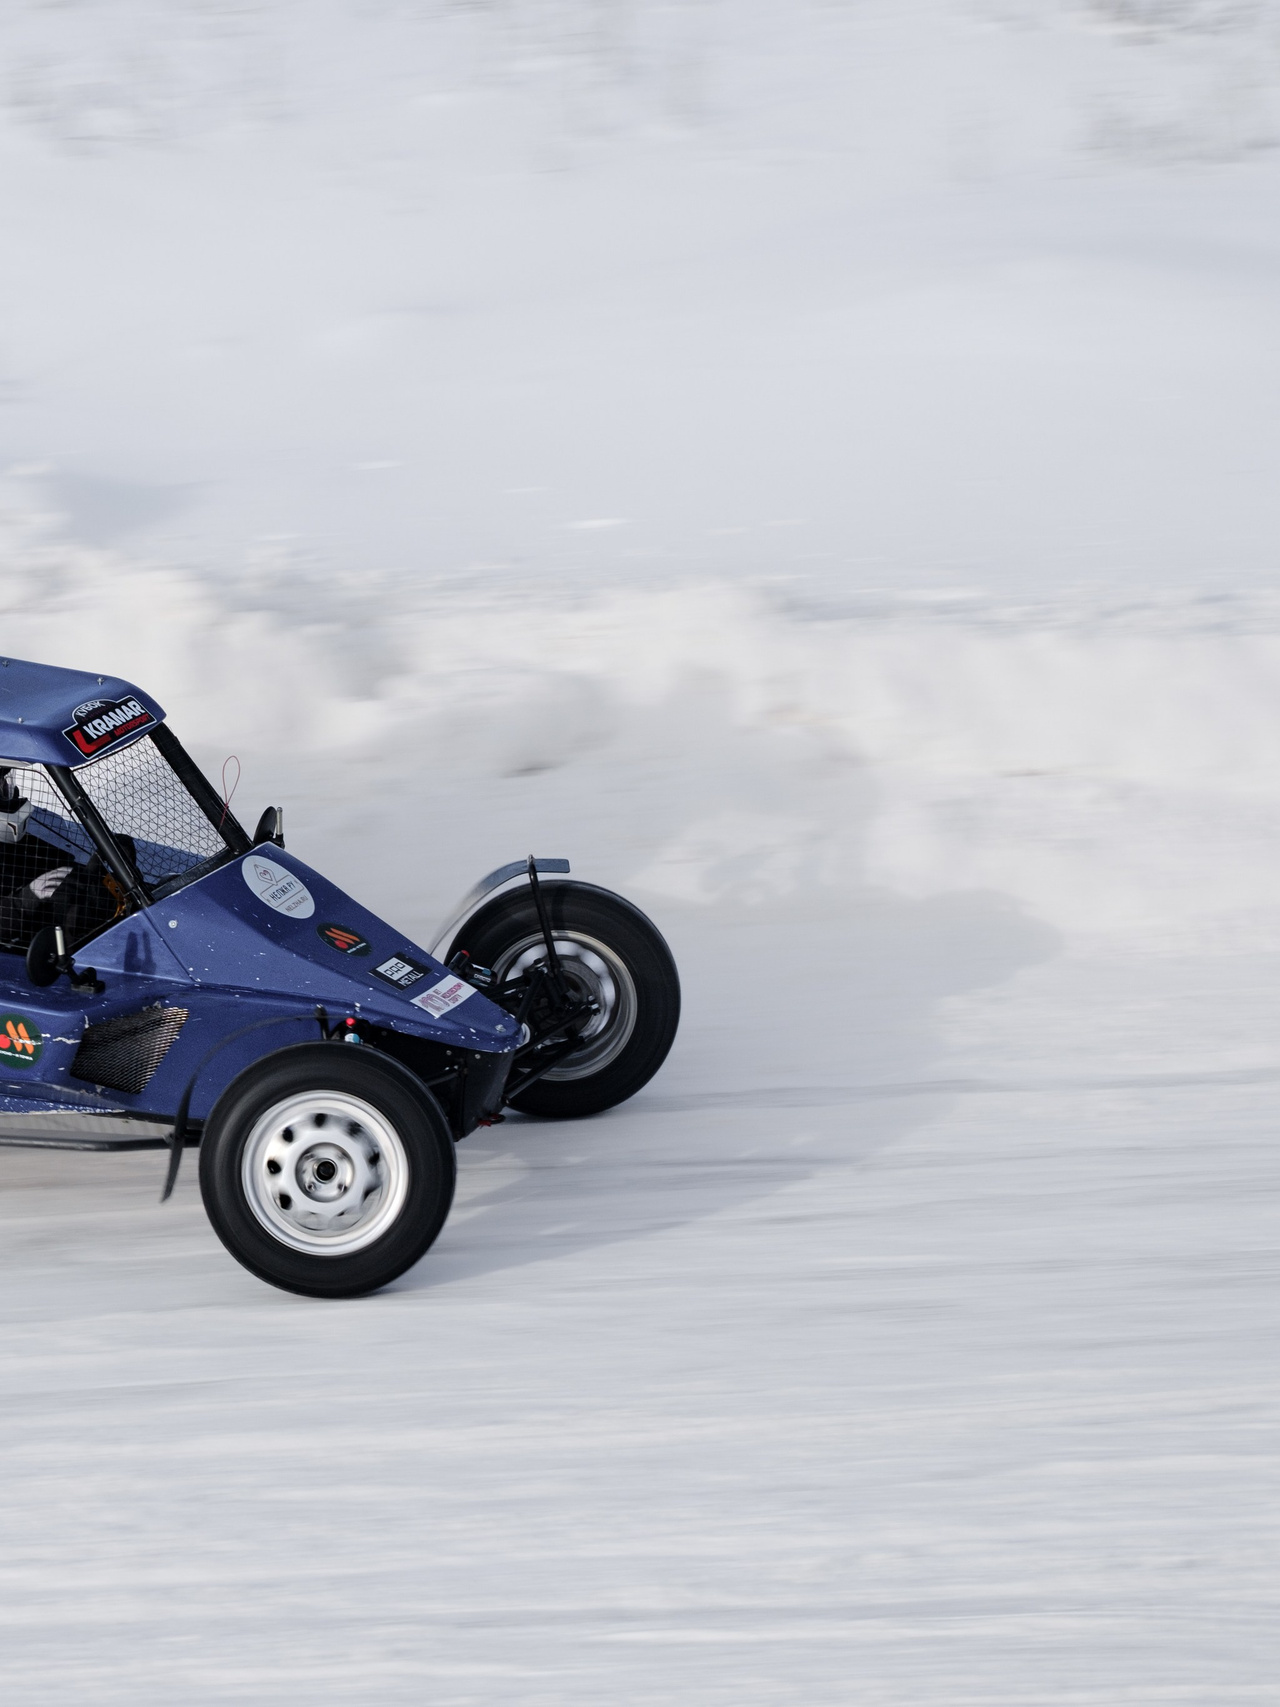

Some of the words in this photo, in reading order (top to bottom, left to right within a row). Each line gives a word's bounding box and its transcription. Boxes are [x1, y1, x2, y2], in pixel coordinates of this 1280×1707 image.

[82, 700, 146, 739] KRAMAR
[113, 714, 151, 737] MOTORSPORT
[384, 961, 406, 978] PRO
[397, 970, 424, 987] METALL
